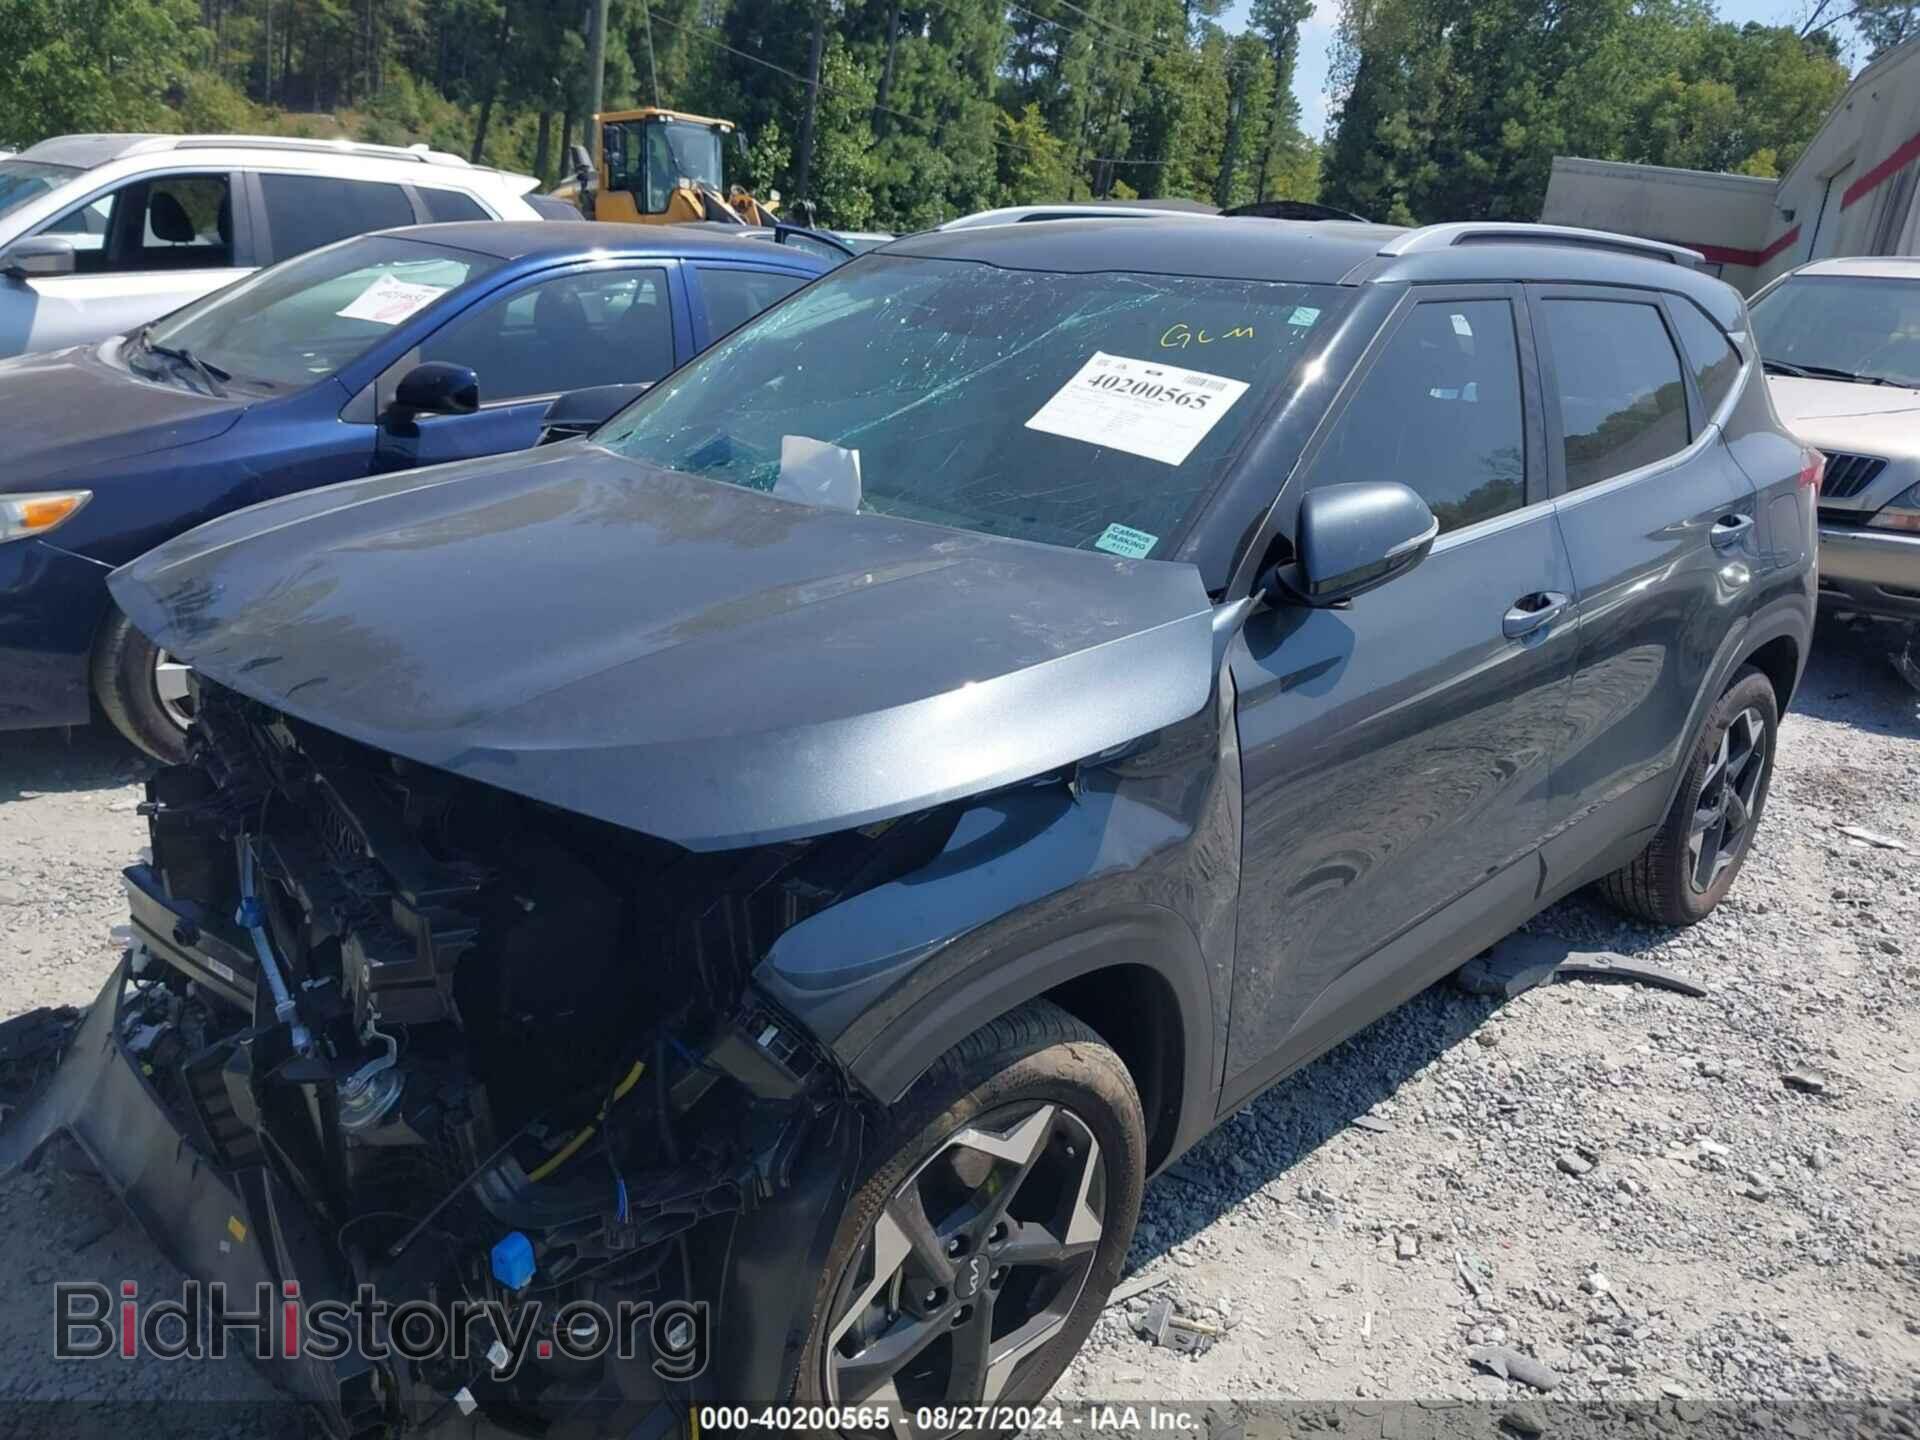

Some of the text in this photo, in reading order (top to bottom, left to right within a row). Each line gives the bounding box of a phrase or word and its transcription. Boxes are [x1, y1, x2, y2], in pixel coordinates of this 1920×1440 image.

[1087, 373, 1212, 410] 40200565
[1106, 533, 1147, 550] PARKING
[1112, 526, 1150, 543] CAMPUS
